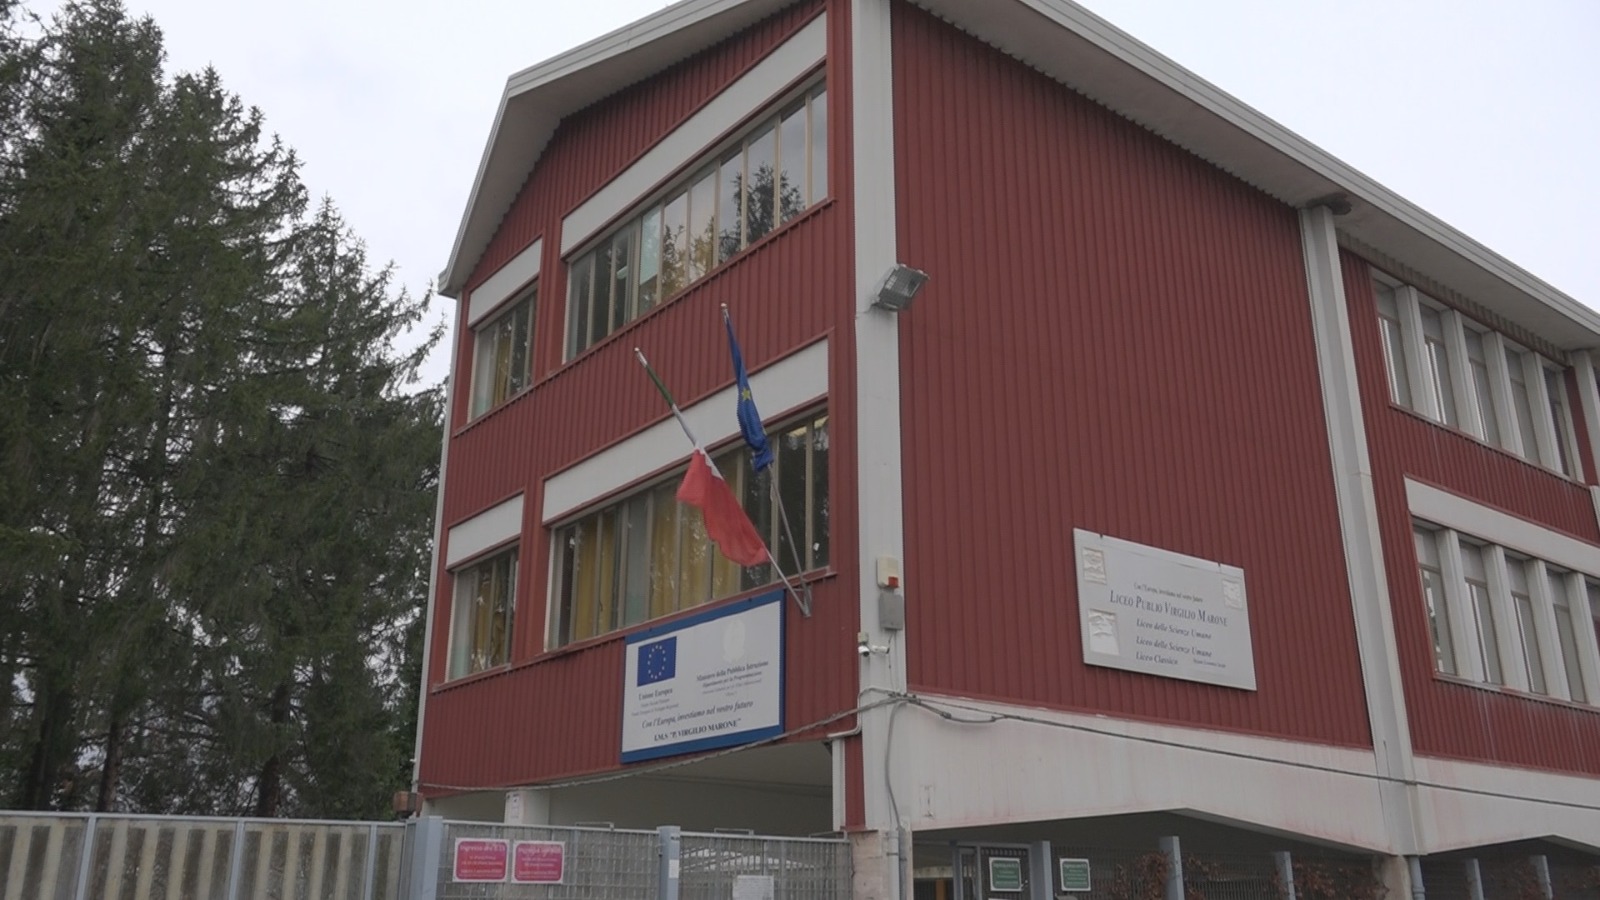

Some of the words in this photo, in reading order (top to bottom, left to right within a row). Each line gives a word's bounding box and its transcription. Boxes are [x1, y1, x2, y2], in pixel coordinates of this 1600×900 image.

[1136, 596, 1163, 612] PUBLIO
[1164, 601, 1196, 620] VIRGILIO
[1197, 609, 1228, 627] MARONE
[1136, 618, 1152, 628] Liceo
[1154, 622, 1168, 631] delle
[1168, 624, 1190, 636] Scienze
[1191, 629, 1212, 639] Umane
[1136, 635, 1152, 646] Liceo
[1154, 639, 1168, 649] delle
[1168, 641, 1190, 653] Scienze
[1191, 646, 1212, 657] Umane
[1135, 651, 1153, 661] Liceo
[1154, 654, 1178, 665] Classico
[641, 720, 652, 728] Con
[677, 710, 705, 721] investiamo
[706, 705, 715, 715] nel
[716, 703, 734, 713] vostro
[734, 701, 754, 712] futuro
[678, 726, 707, 737] VIRGILIO
